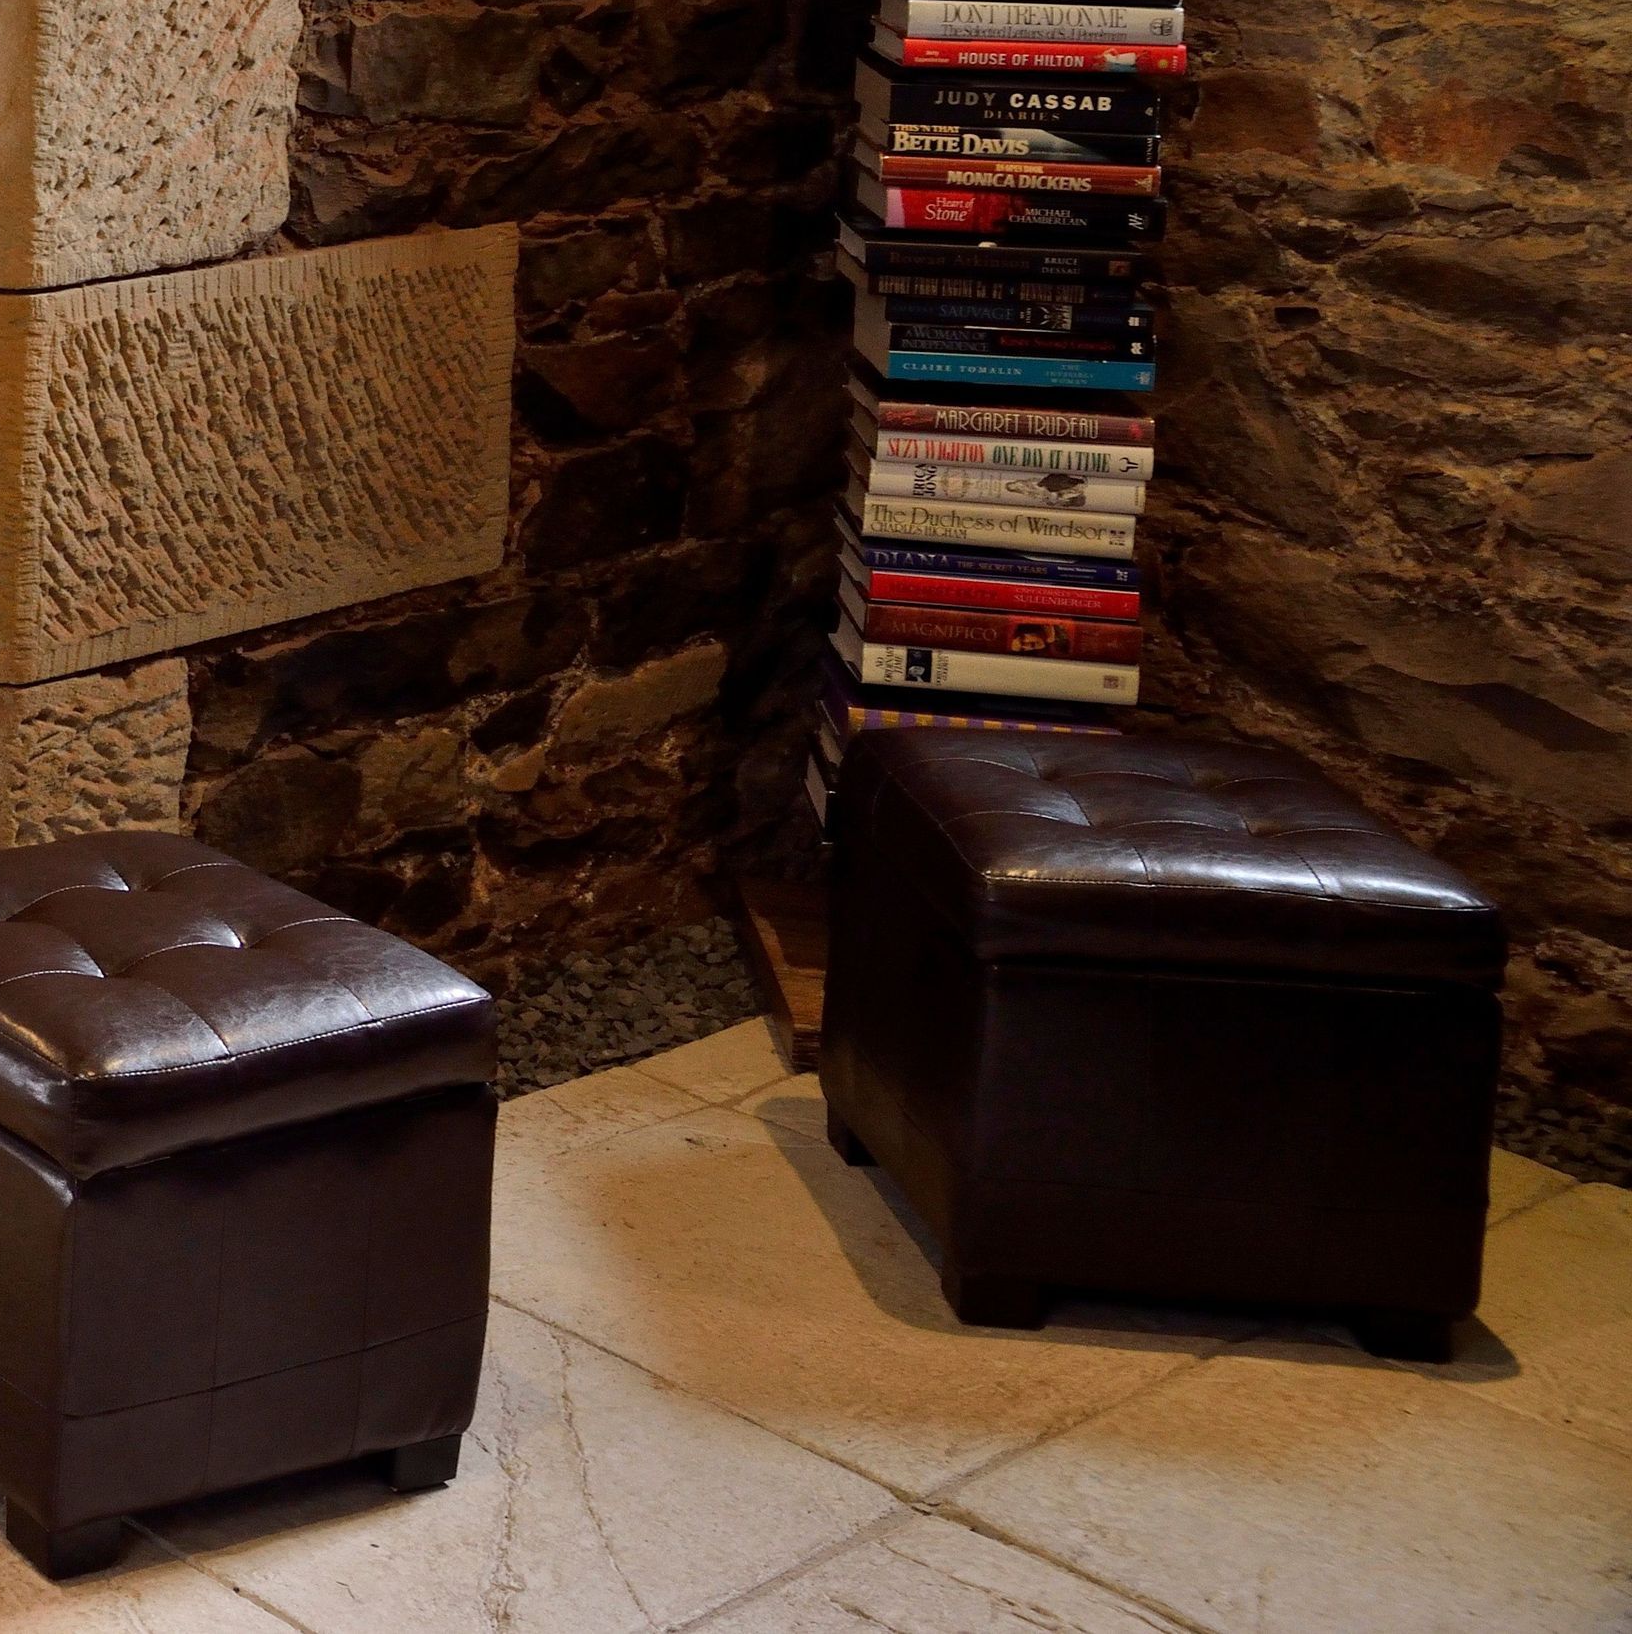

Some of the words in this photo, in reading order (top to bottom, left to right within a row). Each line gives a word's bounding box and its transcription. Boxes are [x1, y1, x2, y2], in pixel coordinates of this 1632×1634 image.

[959, 52, 1006, 65] HOUSE
[1012, 54, 1029, 66] OF
[1035, 55, 1084, 67] HILTON
[934, 91, 996, 105] JUDY
[1010, 94, 1112, 111] CASSAB
[984, 110, 1059, 120] DIARIES
[893, 132, 960, 151] BETTE
[961, 134, 1029, 155] DAVIS
[947, 170, 1015, 188] MONICA
[1018, 175, 1092, 191] DICKENS
[926, 204, 967, 221] Stone
[903, 362, 951, 372] CLAIRE
[960, 366, 1022, 376] TOMALIN
[936, 411, 1021, 435] MARGARET
[1027, 416, 1099, 438] TRUDEAU
[871, 504, 910, 523] The
[912, 506, 994, 532] Duchess
[1000, 516, 1021, 533] of
[1026, 516, 1107, 540] Windsor
